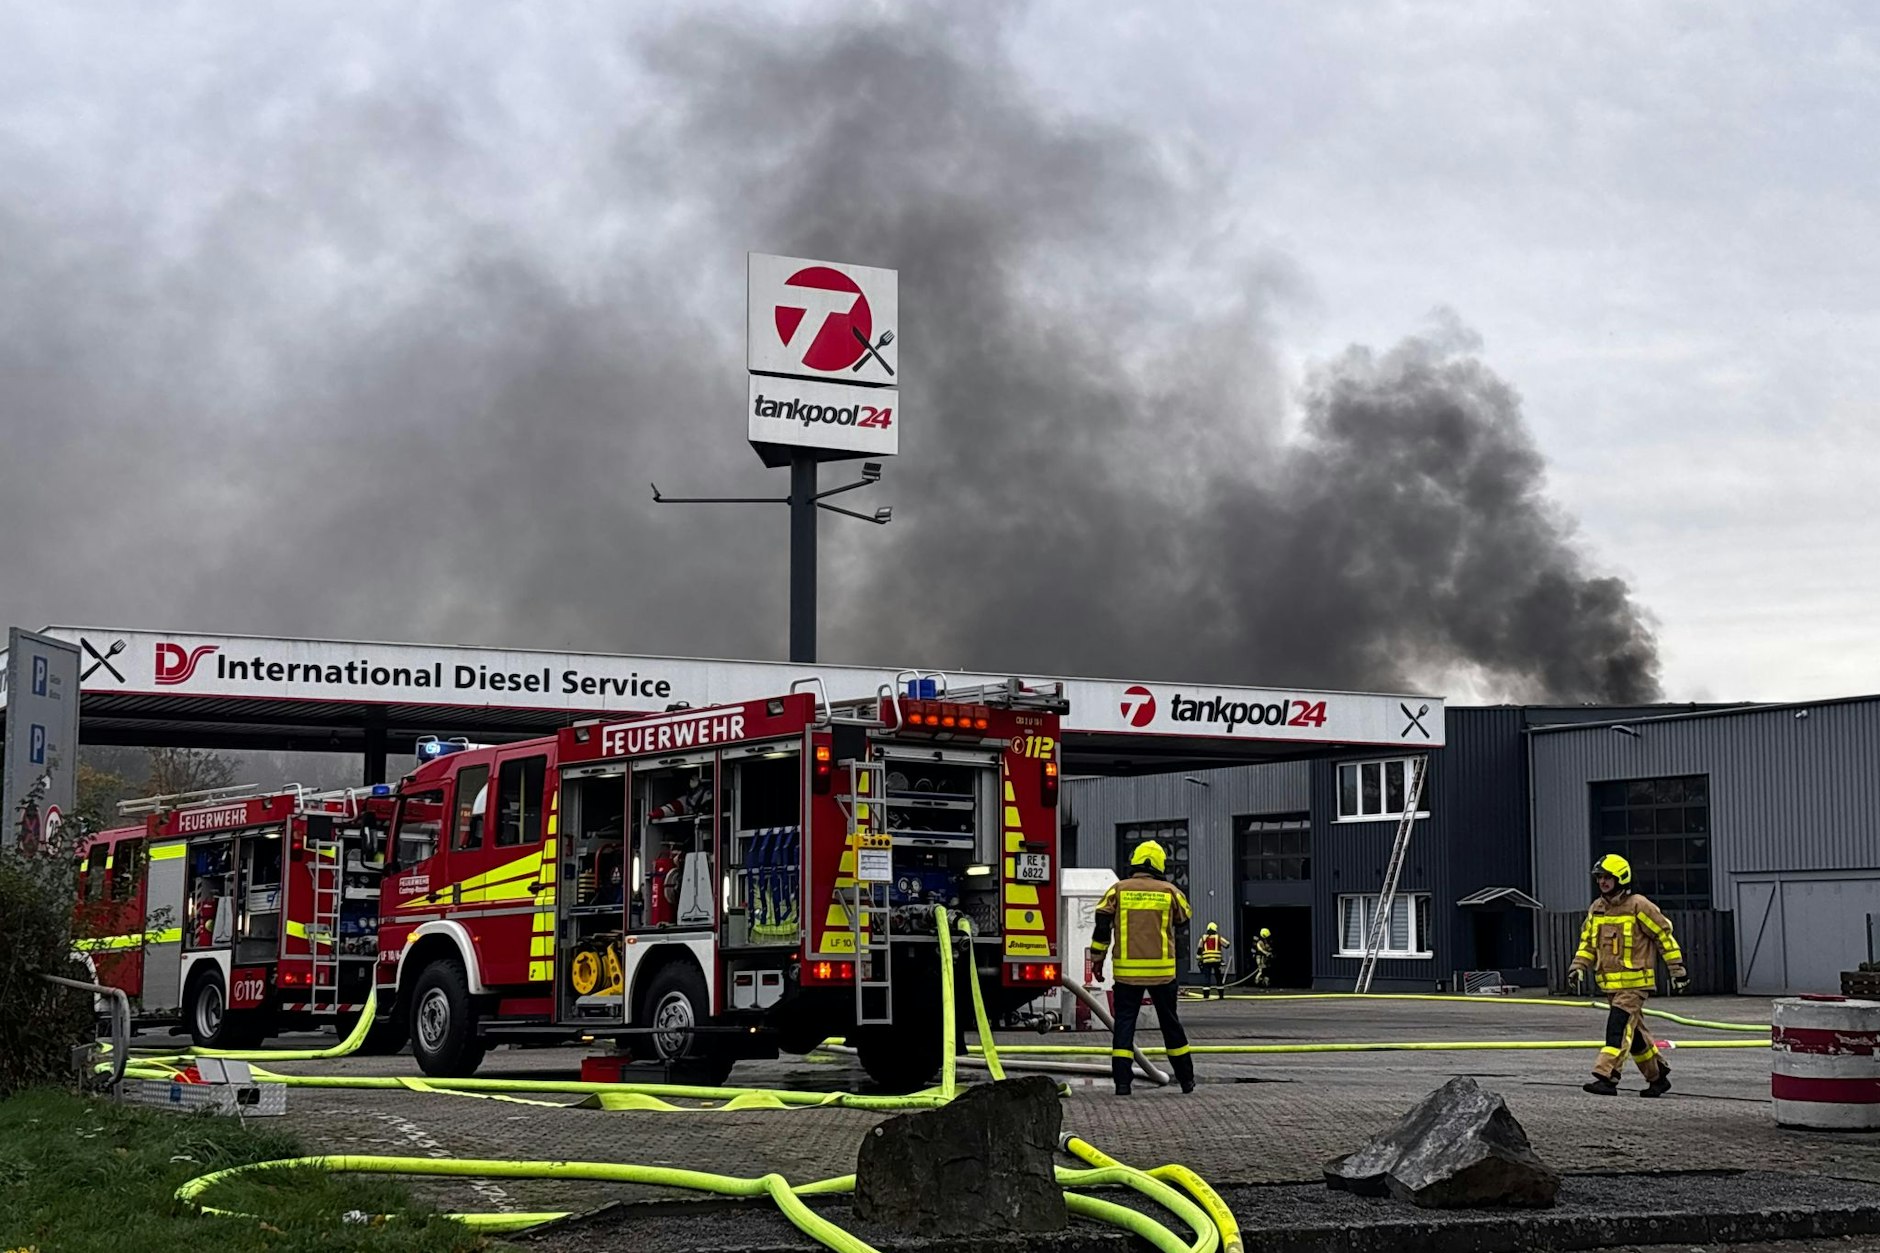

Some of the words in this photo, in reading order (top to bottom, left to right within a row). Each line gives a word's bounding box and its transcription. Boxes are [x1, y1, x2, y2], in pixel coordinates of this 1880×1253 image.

[754, 395, 893, 430] tankpool24
[155, 643, 220, 685] DS
[218, 654, 442, 687] International
[454, 665, 550, 692] Diesel
[562, 670, 672, 698] Service
[1171, 694, 1327, 733] tankpool24
[602, 706, 745, 756] FEUERWEHR
[1025, 735, 1054, 759] 112
[179, 803, 248, 832] FEUERWEHR
[1027, 855, 1038, 866] RE
[1022, 867, 1044, 879] 6822
[830, 938, 841, 947] LF
[1008, 940, 1047, 950] Schlingmann
[244, 980, 264, 1001] 112
